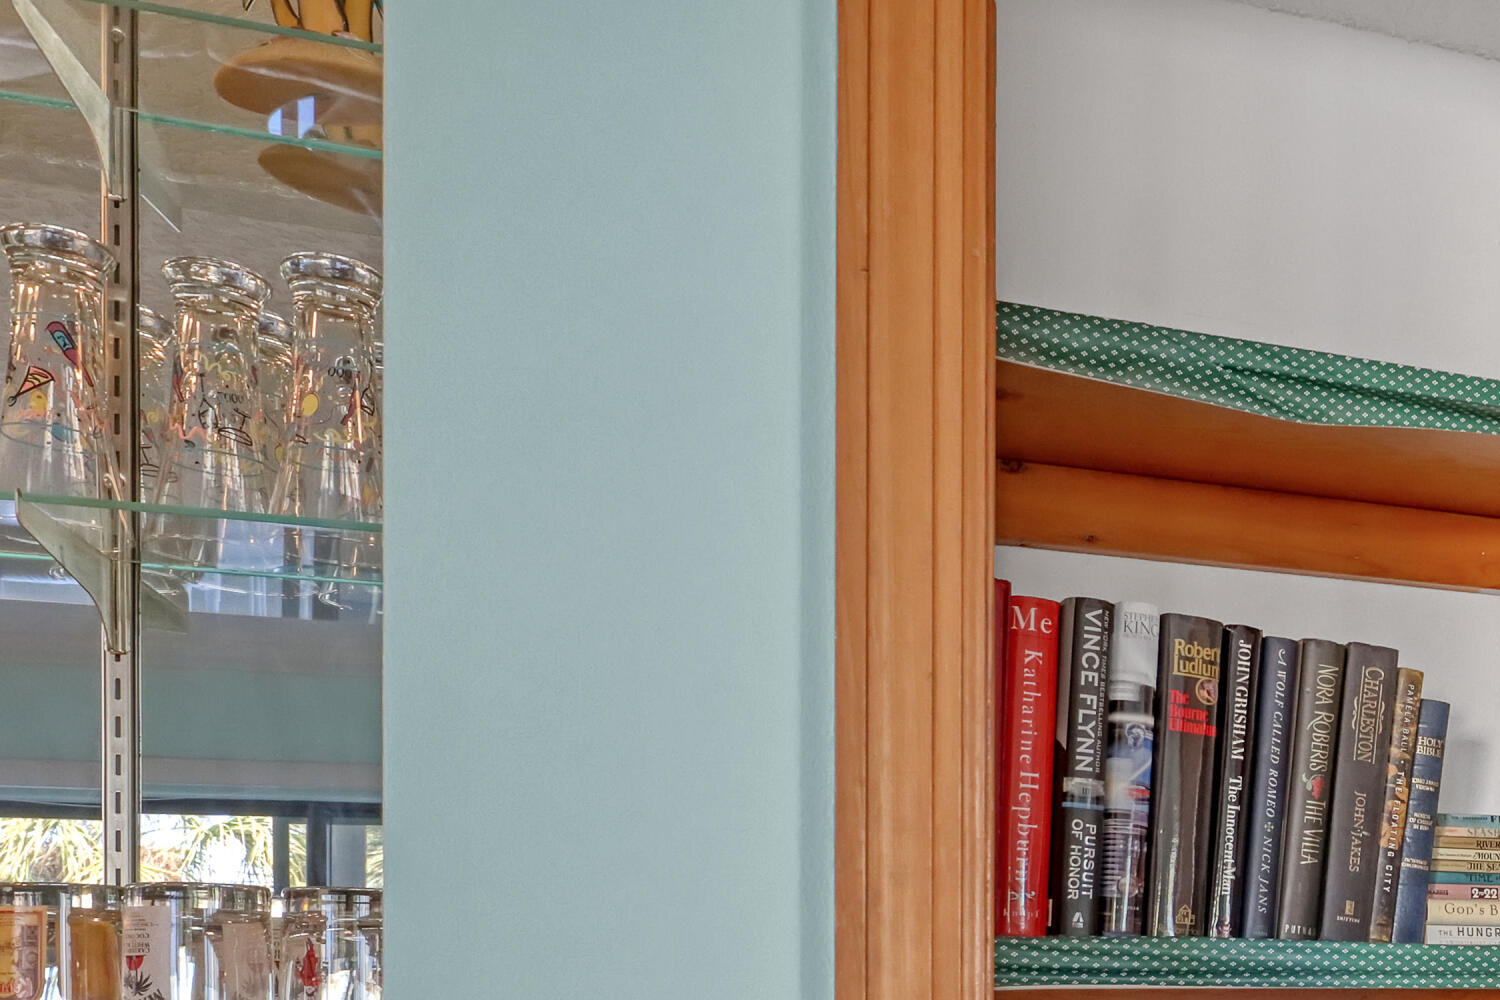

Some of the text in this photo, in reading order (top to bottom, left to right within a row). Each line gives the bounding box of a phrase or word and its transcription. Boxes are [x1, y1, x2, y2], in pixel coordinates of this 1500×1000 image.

[1010, 605, 1053, 634] Me
[1018, 648, 1043, 765] Katharine
[1074, 609, 1103, 772] VINCE FLYNN
[1231, 639, 1252, 760] JOHN GRISHAM
[1274, 670, 1287, 709] WOLF
[1356, 666, 1385, 763] CHARLESTON
[1270, 711, 1284, 764] CALLED
[1306, 663, 1339, 772] NORA ROBERTS
[1418, 736, 1444, 749] HOLY
[1415, 745, 1441, 758] BIBLE
[1265, 768, 1279, 818] ROMEO
[1382, 684, 1415, 893] PAMELA BALL THE FLOATING CITY
[1221, 775, 1243, 895] The Innocent Man
[1260, 835, 1273, 874] NICK
[1299, 799, 1327, 865] THE VILLA
[1348, 790, 1367, 873] JOHN JAKES
[1066, 818, 1084, 900] OF HONOR
[1081, 823, 1097, 900] PURSUIT
[1467, 862, 1485, 871] THE
[1467, 874, 1493, 883] TIME
[1257, 874, 1270, 914] JANS
[1444, 902, 1485, 915] GOD'S
[1439, 929, 1453, 937] THE
